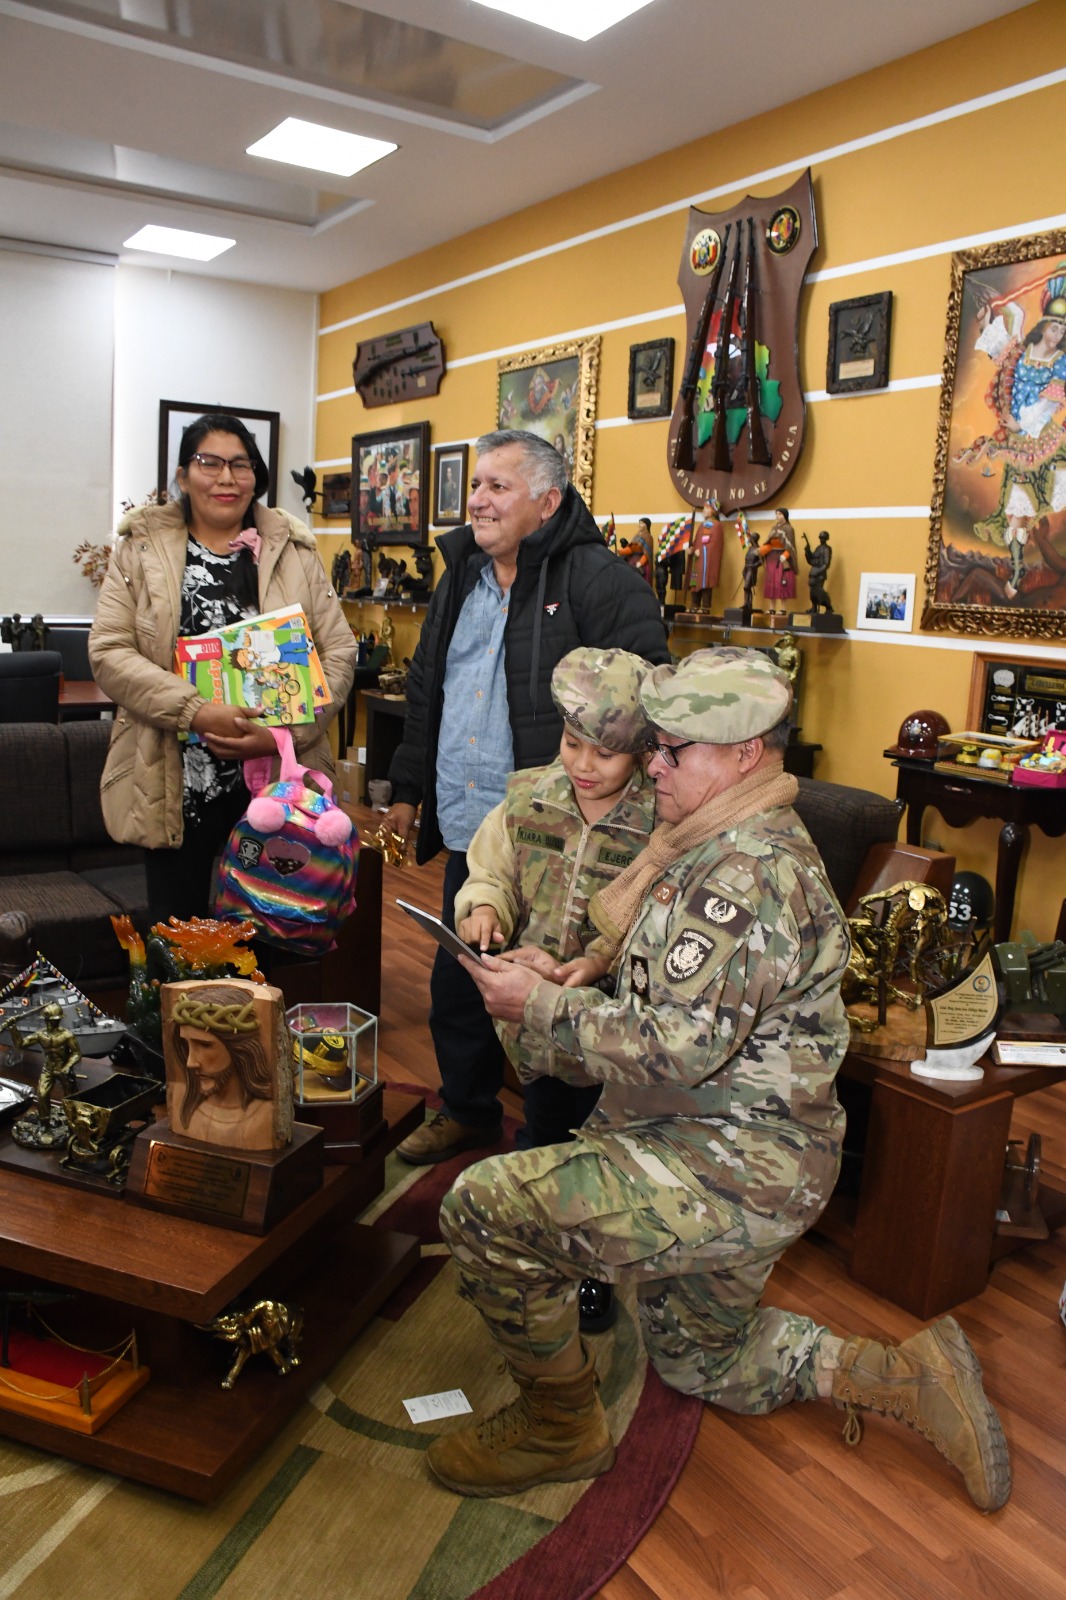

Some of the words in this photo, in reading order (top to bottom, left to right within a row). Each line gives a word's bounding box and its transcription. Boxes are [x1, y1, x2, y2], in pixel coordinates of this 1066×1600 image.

[676, 469, 719, 500] PATRIA
[729, 488, 745, 500] NO
[754, 480, 768, 496] SE
[776, 425, 798, 472] TOCA
[207, 658, 223, 704] Ready
[519, 829, 542, 843] KIARA
[949, 901, 972, 921] 53
